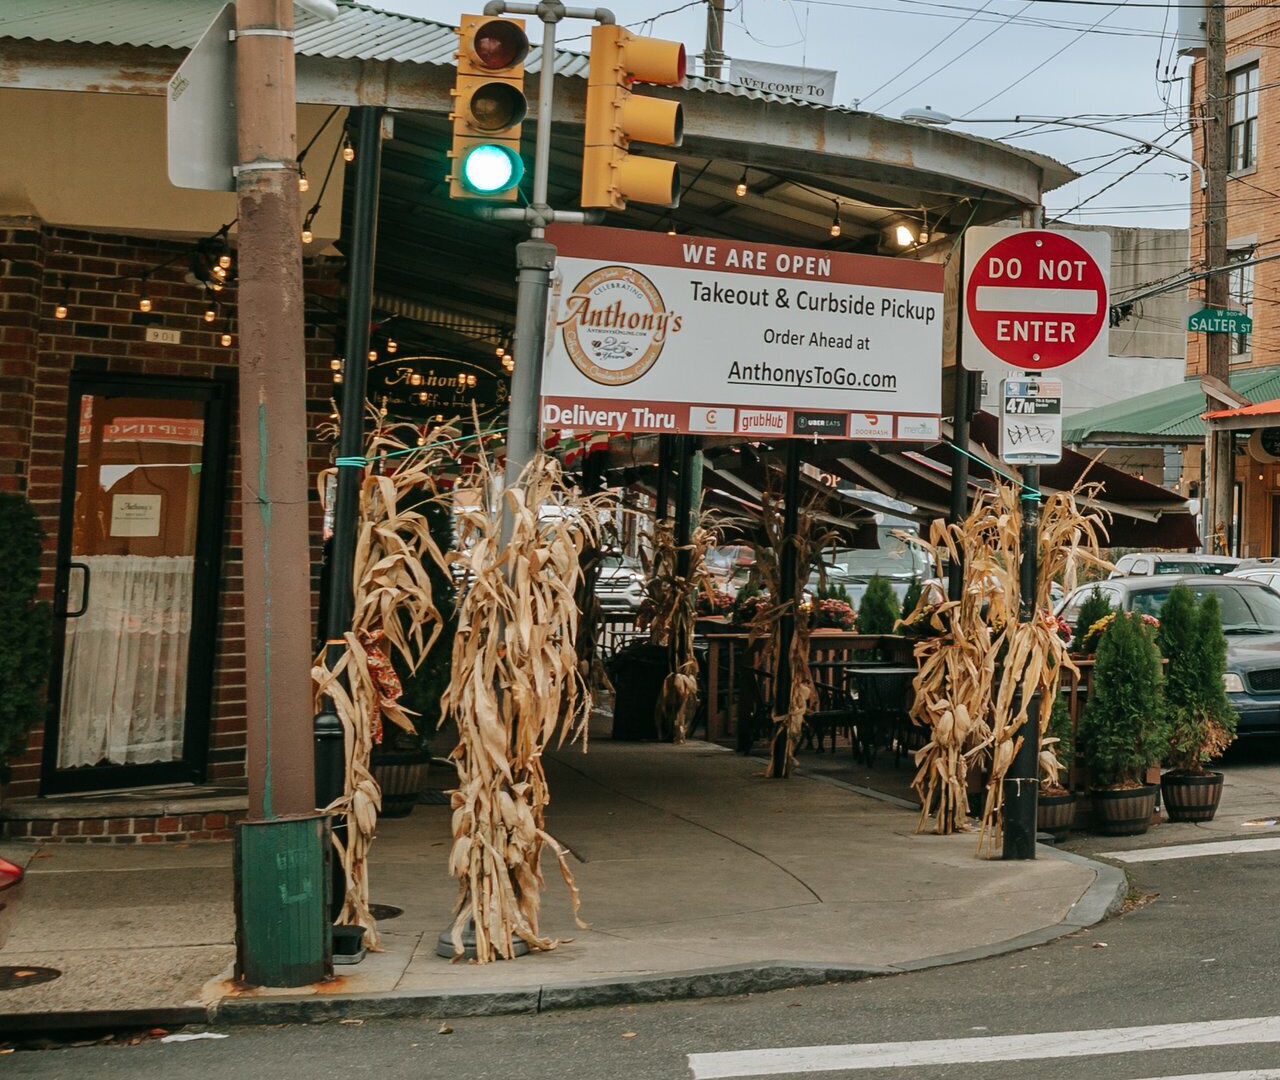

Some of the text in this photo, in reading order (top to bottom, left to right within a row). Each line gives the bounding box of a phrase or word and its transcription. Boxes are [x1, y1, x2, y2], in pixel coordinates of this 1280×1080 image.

[683, 243, 831, 276] WE ARE OPEN
[989, 257, 1087, 281] DO NOT
[594, 282, 643, 299] CELEBRATING
[690, 281, 935, 324] Takeout & Curbside Pickup
[556, 296, 683, 342] Anthony's
[1191, 318, 1250, 332] SALTER ST
[153, 331, 175, 343] 901
[764, 329, 869, 350] Order Ahead at
[997, 320, 1076, 343] ENTER
[728, 361, 897, 388] AnthonysToGo.com
[1007, 398, 1035, 413] 47M
[544, 404, 675, 431] Delivery Thru
[742, 412, 783, 430] grubHub
